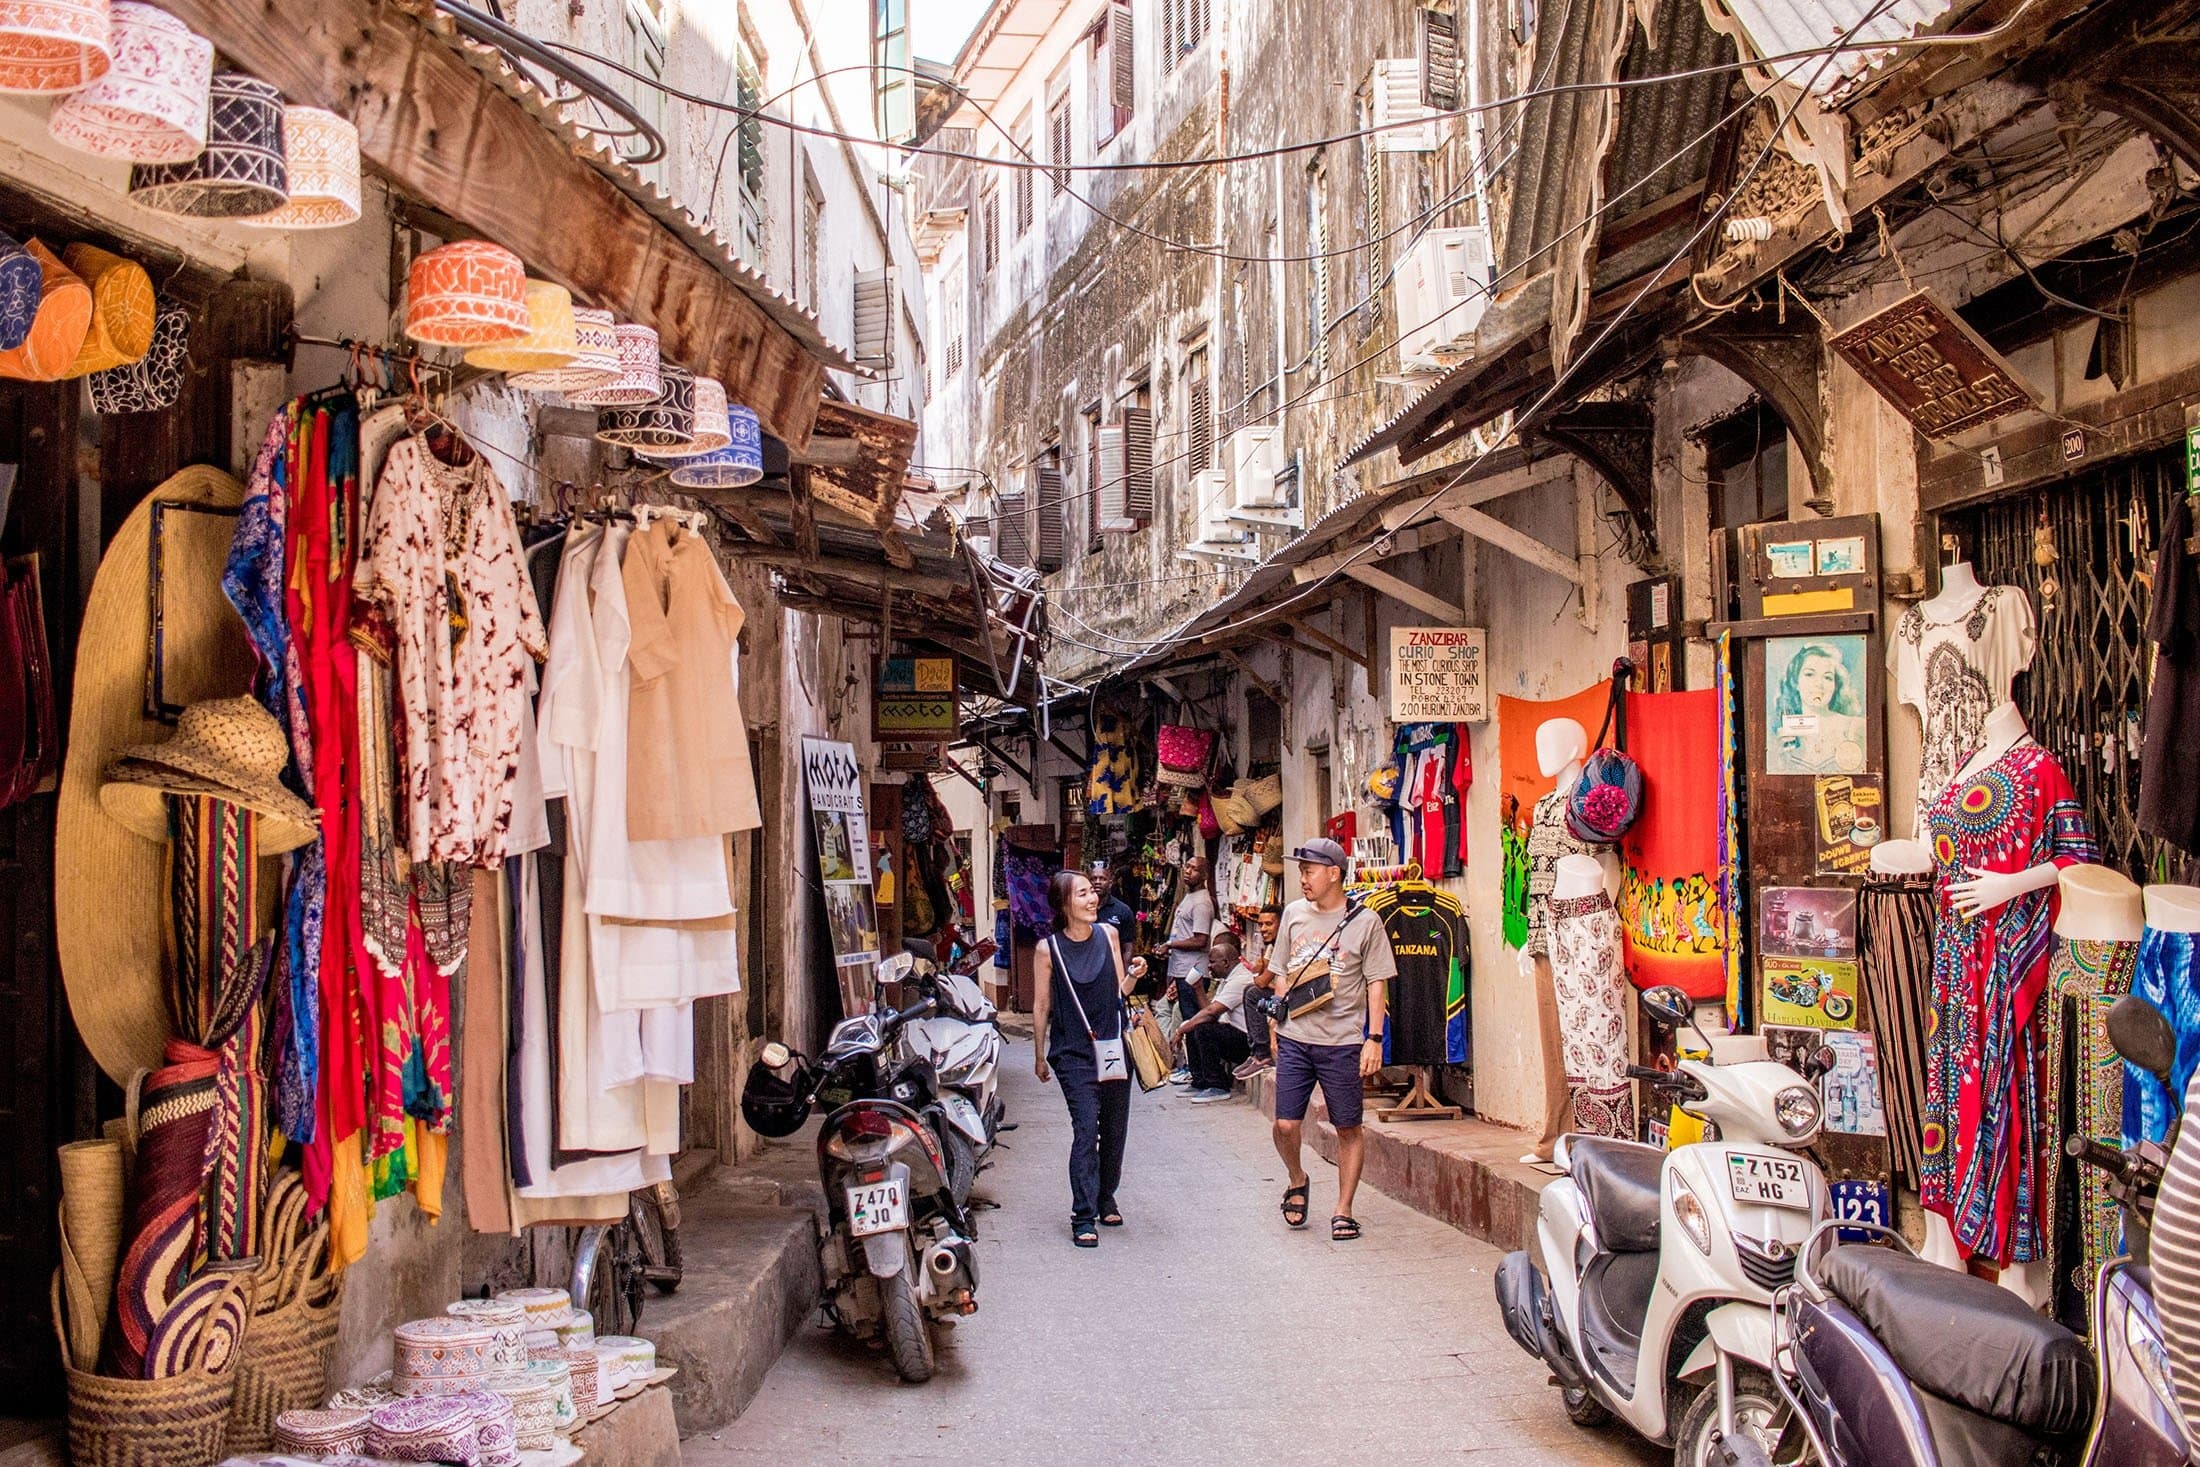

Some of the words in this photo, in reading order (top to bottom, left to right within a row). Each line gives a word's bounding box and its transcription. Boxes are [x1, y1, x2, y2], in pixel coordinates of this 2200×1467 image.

[1912, 363, 1965, 399] SHOP
[2064, 436, 2082, 454] 200
[1409, 632, 1468, 646] ZANZIBAR
[1398, 646, 1434, 659] CURIO
[1448, 646, 1480, 659] SHOP
[1399, 660, 1411, 673] THE
[1411, 660, 1428, 673] MOST
[1432, 660, 1460, 673] CURIOUS
[1461, 660, 1478, 673] SHOP
[1400, 673, 1412, 686] IN
[1415, 673, 1448, 686] STONE
[1455, 673, 1479, 686] TOWN
[1435, 686, 1474, 695] 2232077
[1400, 703, 1420, 716] 200
[1421, 703, 1452, 716] HURUMZI
[1453, 703, 1481, 716] ZANZIBAR
[1819, 844, 1851, 862] DOUWE
[1832, 849, 1870, 870] EGBERTS
[1747, 1159, 1758, 1176] Z
[1763, 1161, 1801, 1182] 152
[854, 1193, 865, 1209] Z
[867, 1187, 898, 1206] 470
[1735, 1186, 1750, 1194] EAZ
[1758, 1182, 1783, 1200] HG
